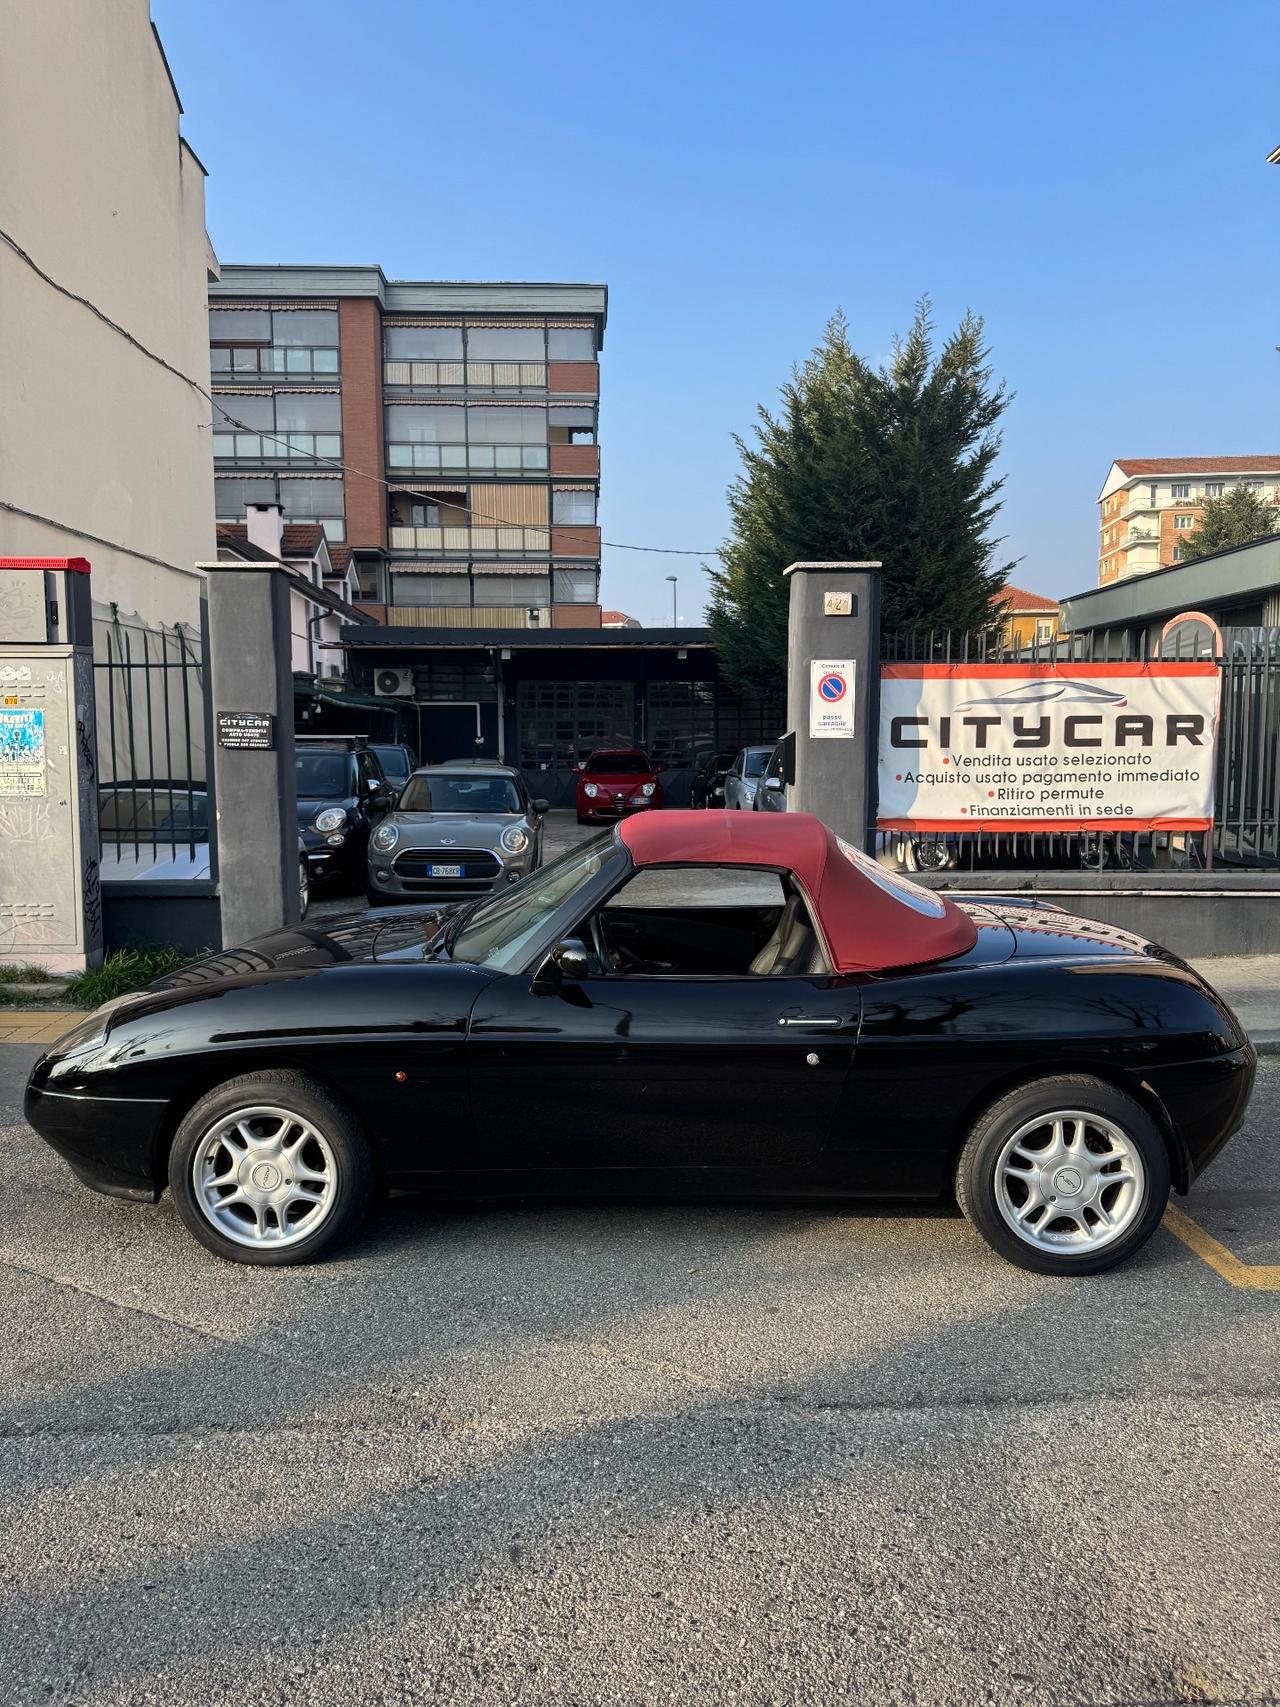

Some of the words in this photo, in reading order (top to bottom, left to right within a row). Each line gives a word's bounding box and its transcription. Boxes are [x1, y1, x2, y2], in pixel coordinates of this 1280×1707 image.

[891, 714, 1204, 749] CITYCAR
[952, 755, 1011, 767] Vendita
[1016, 756, 1058, 767] usato
[1063, 754, 1152, 767] selezionato
[904, 772, 971, 785] Acquisto
[976, 773, 1017, 784] usato
[1022, 772, 1112, 786] pagamento
[1117, 770, 1200, 782] immediato
[997, 788, 1035, 800] Ritiro
[1040, 789, 1105, 802] permute
[970, 804, 1074, 816] Finanziamenti
[1079, 804, 1092, 816] in
[1096, 803, 1134, 815] sede
